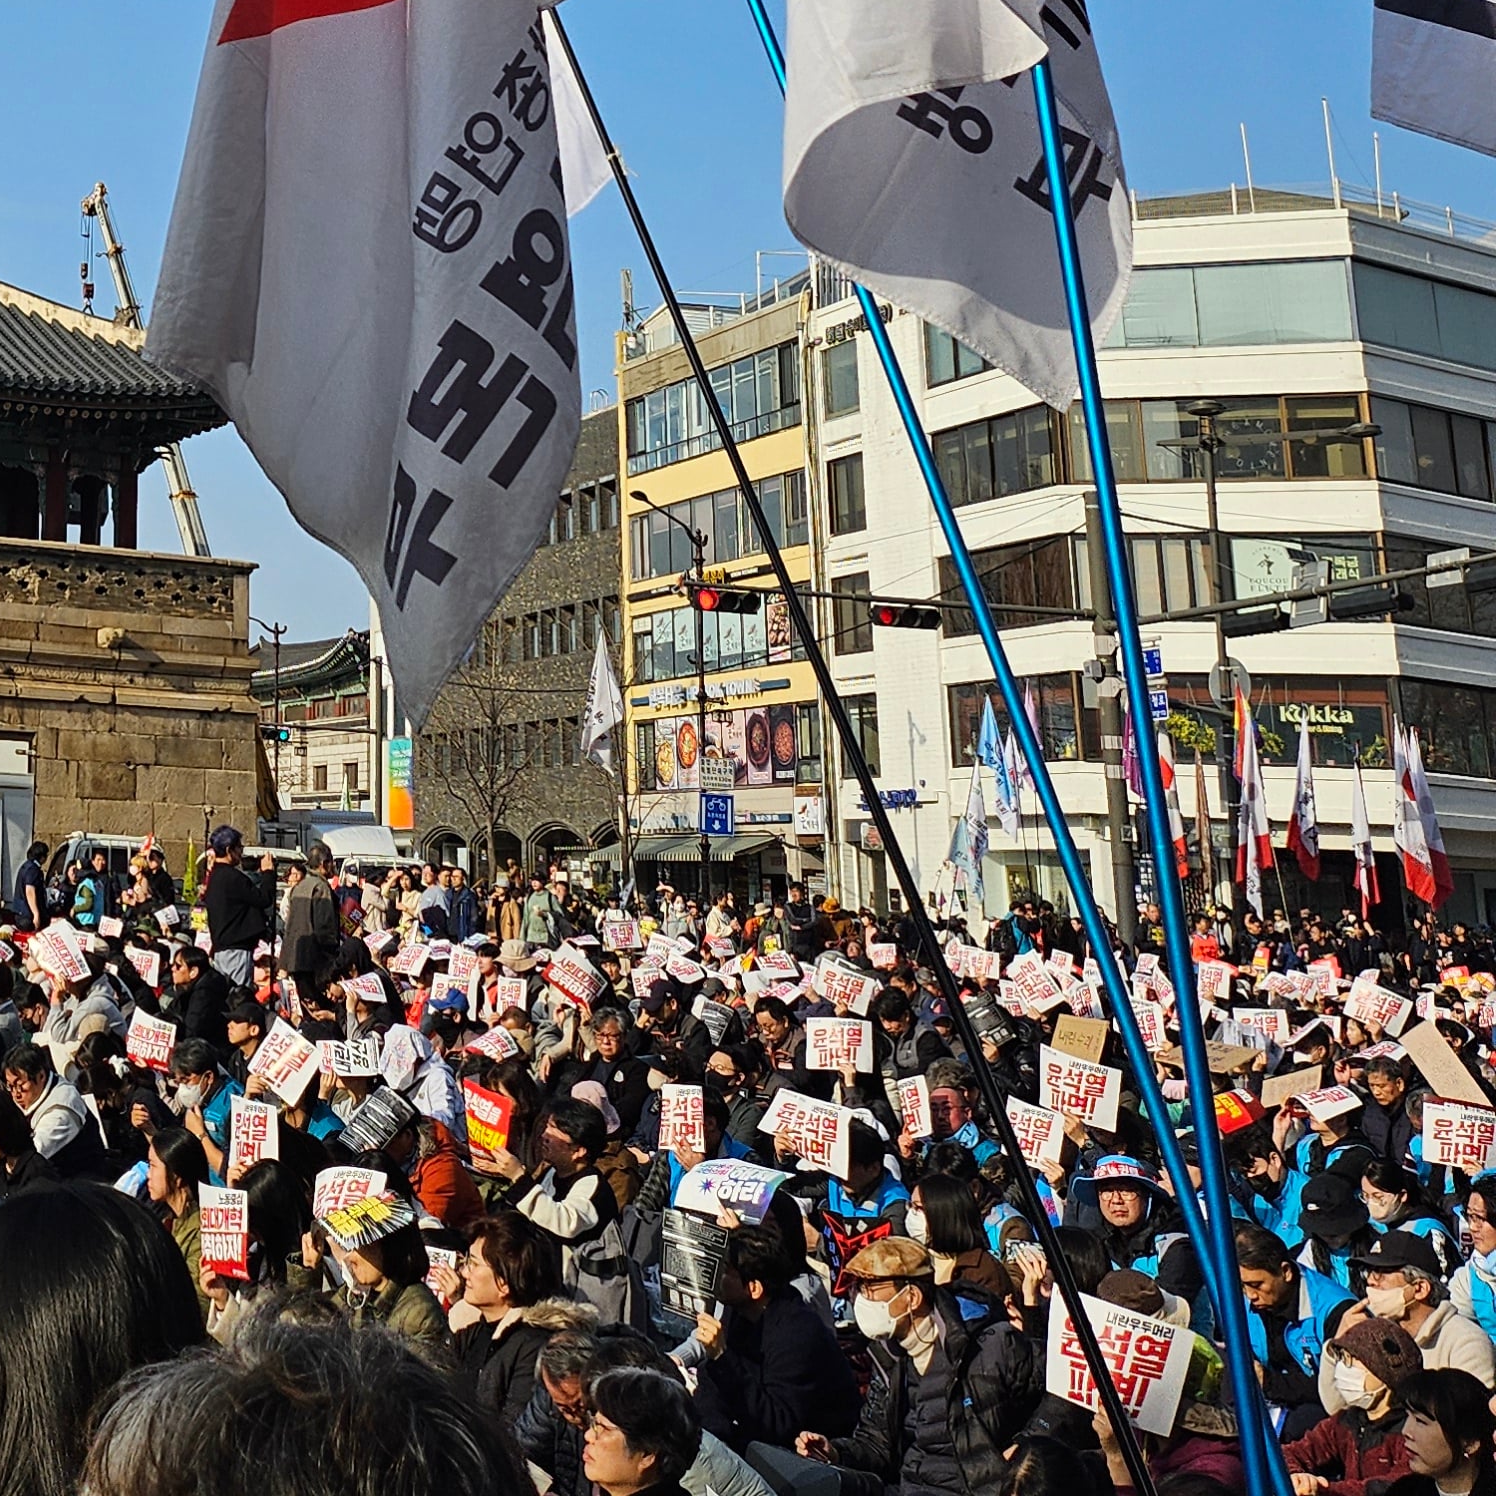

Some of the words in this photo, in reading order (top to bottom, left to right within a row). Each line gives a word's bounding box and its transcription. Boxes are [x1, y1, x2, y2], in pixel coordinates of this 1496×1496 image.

[813, 1027, 863, 1048] 윤석열
[1047, 1062, 1107, 1097] 윤석열
[1433, 1118, 1495, 1145] 윤석열
[200, 1207, 243, 1231] 회대개혁
[201, 1232, 243, 1262] 취하자!
[1105, 1309, 1177, 1341] 내란우두머리
